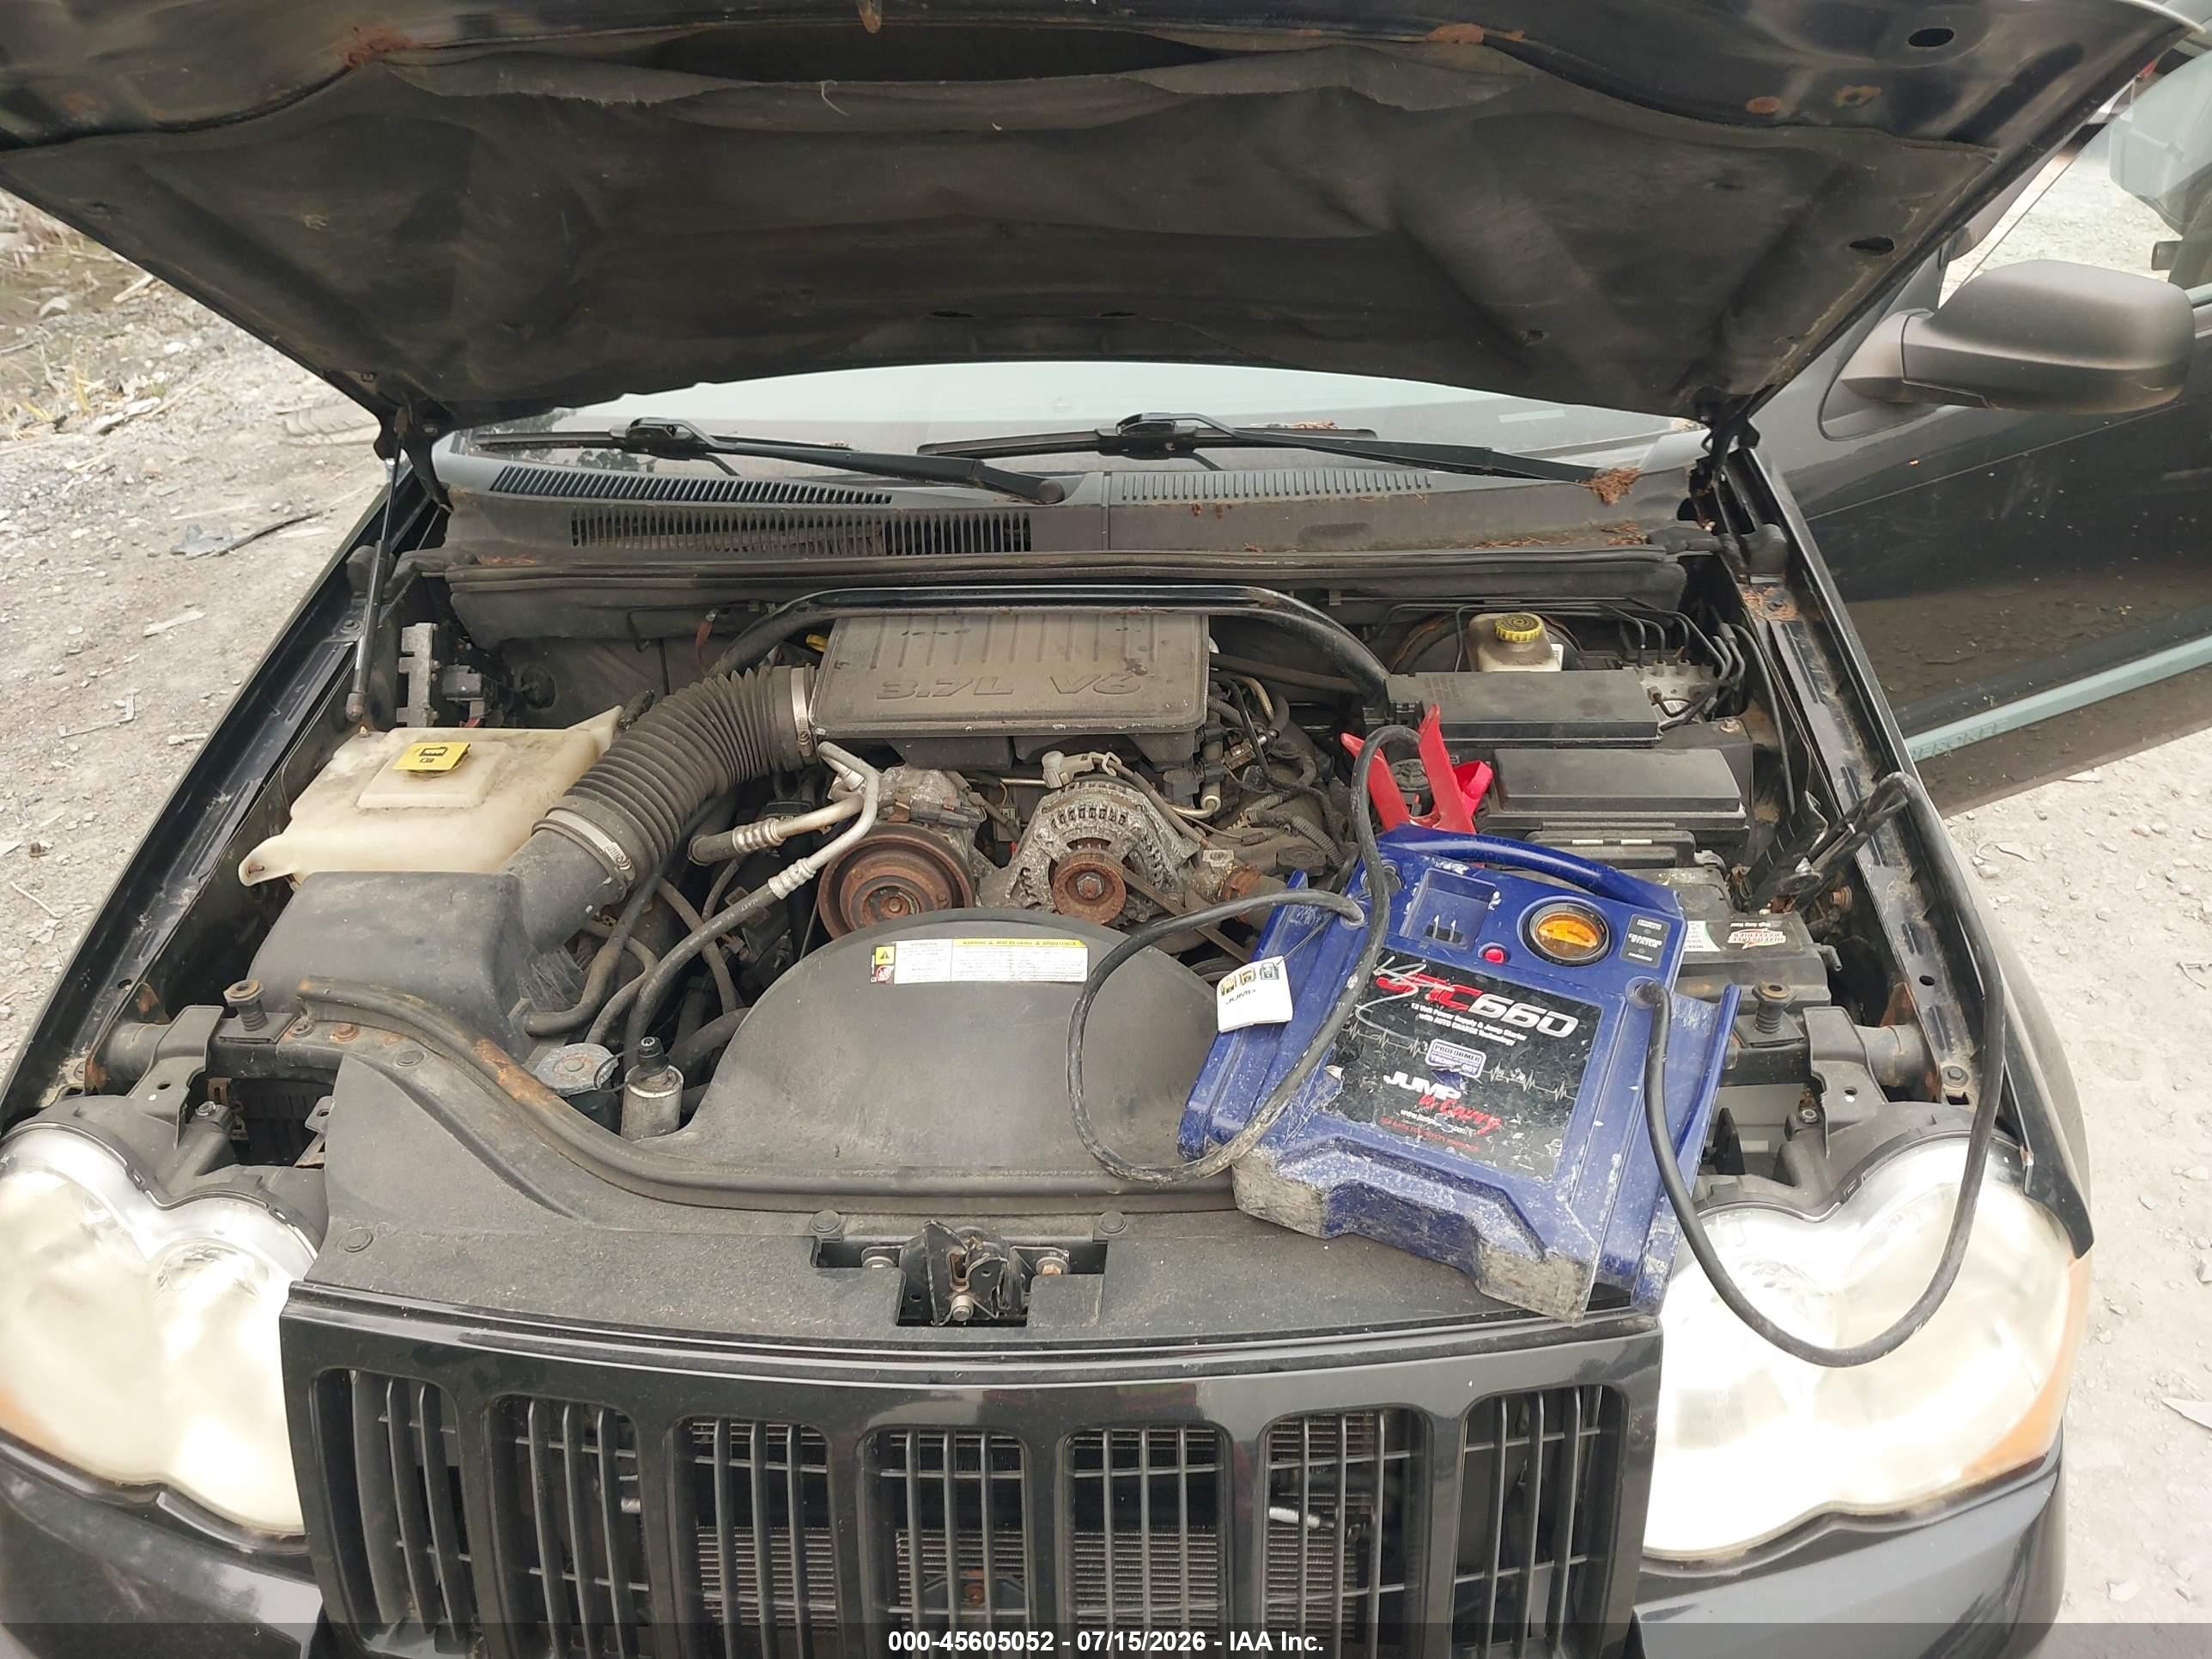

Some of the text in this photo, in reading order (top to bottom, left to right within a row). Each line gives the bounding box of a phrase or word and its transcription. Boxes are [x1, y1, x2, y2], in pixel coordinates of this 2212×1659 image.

[876, 672, 1141, 700] 3.7L V6
[1382, 1070, 1462, 1101] JUMP
